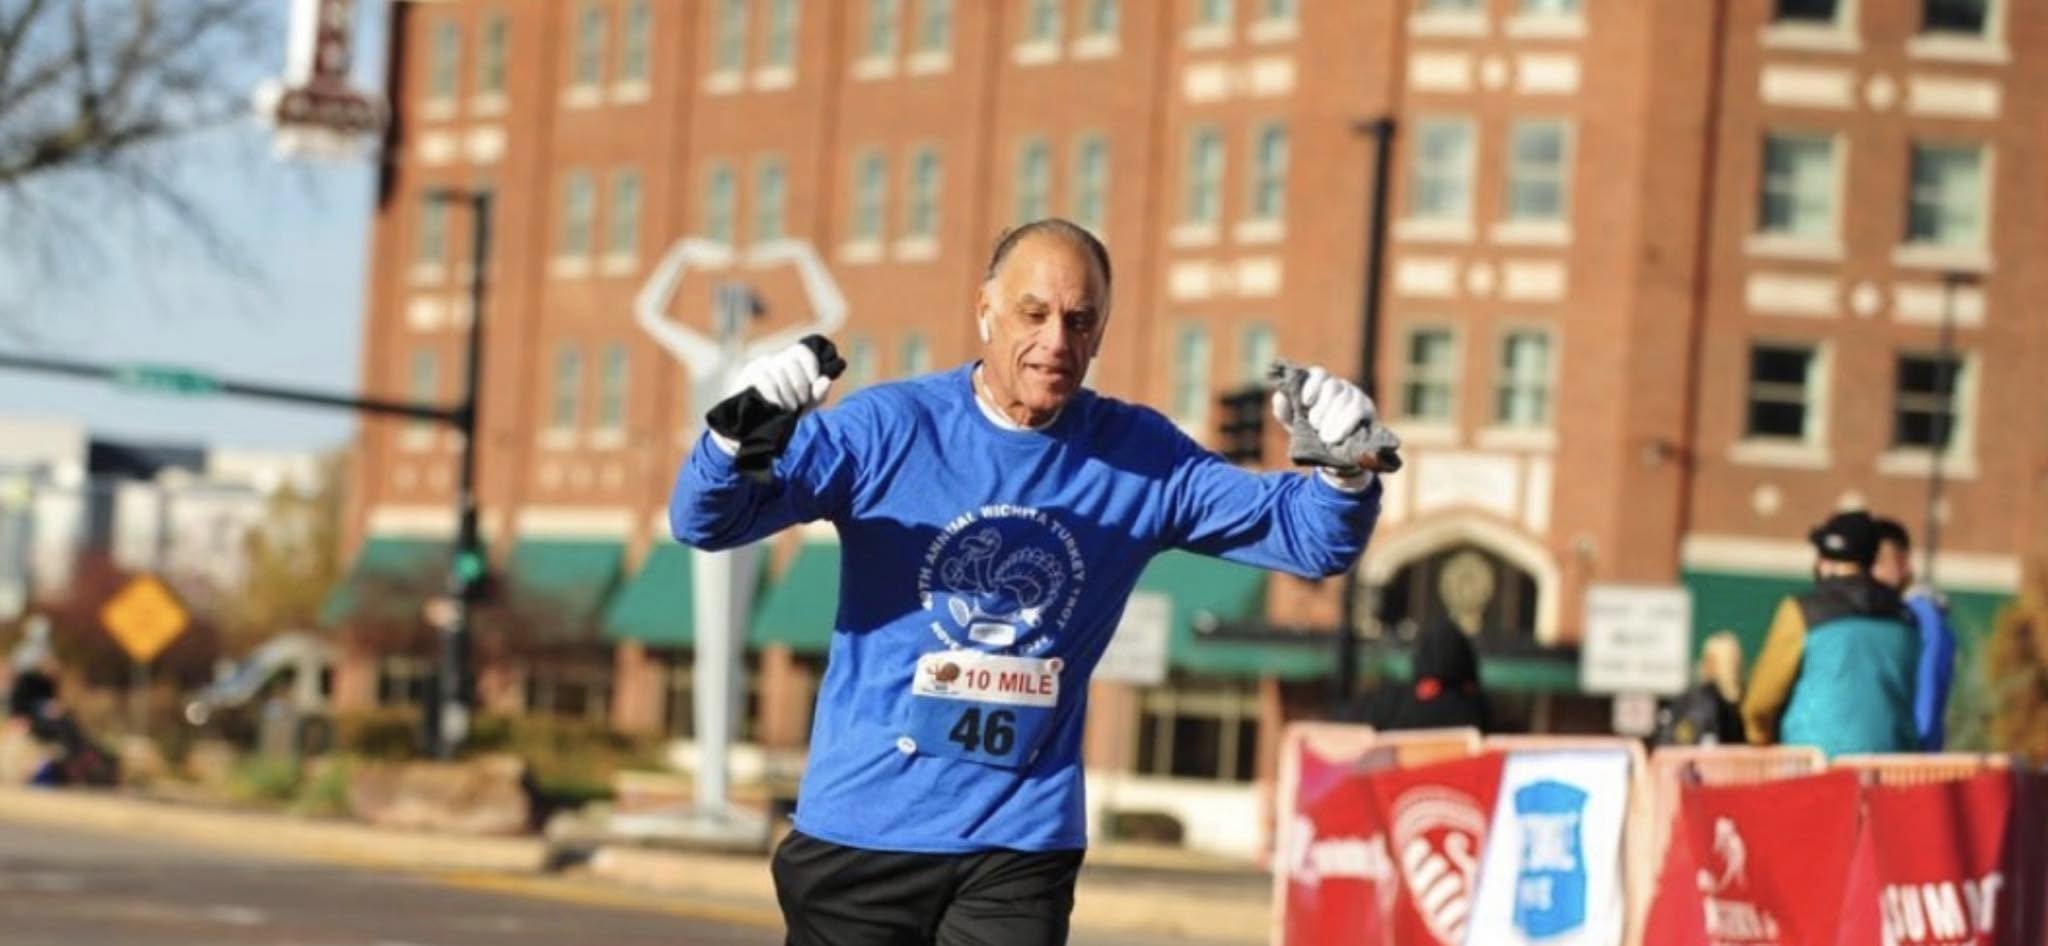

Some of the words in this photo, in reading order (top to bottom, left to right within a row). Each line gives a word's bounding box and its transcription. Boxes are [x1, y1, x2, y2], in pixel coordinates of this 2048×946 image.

[980, 503, 1048, 526] WICHITA
[1050, 519, 1086, 582] TURKEY
[965, 668, 992, 691] 10
[998, 671, 1053, 695] MILE
[948, 706, 1017, 757] 46
